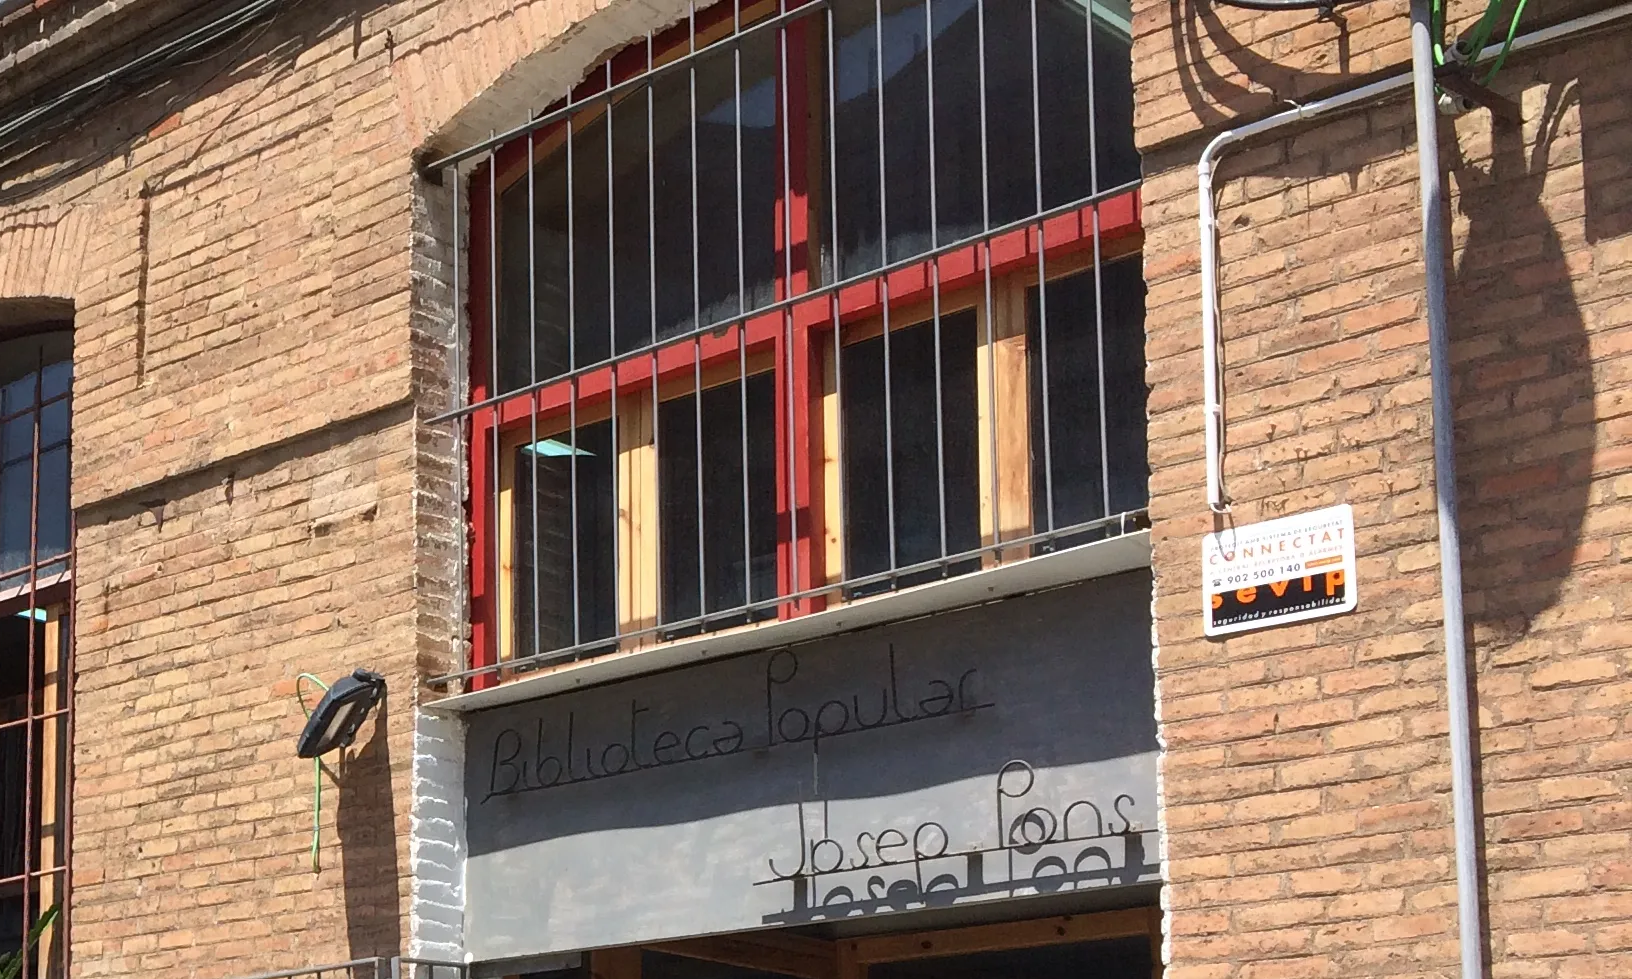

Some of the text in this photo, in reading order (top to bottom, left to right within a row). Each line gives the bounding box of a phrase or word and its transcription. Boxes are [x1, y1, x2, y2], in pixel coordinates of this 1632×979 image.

[1209, 527, 1345, 566] CONNECTAT
[1227, 573, 1249, 585] 902
[1253, 567, 1275, 580] 500
[1279, 562, 1301, 575] 140
[487, 642, 980, 797] Biblioteca Popular
[768, 758, 1137, 904] Josep Pons
